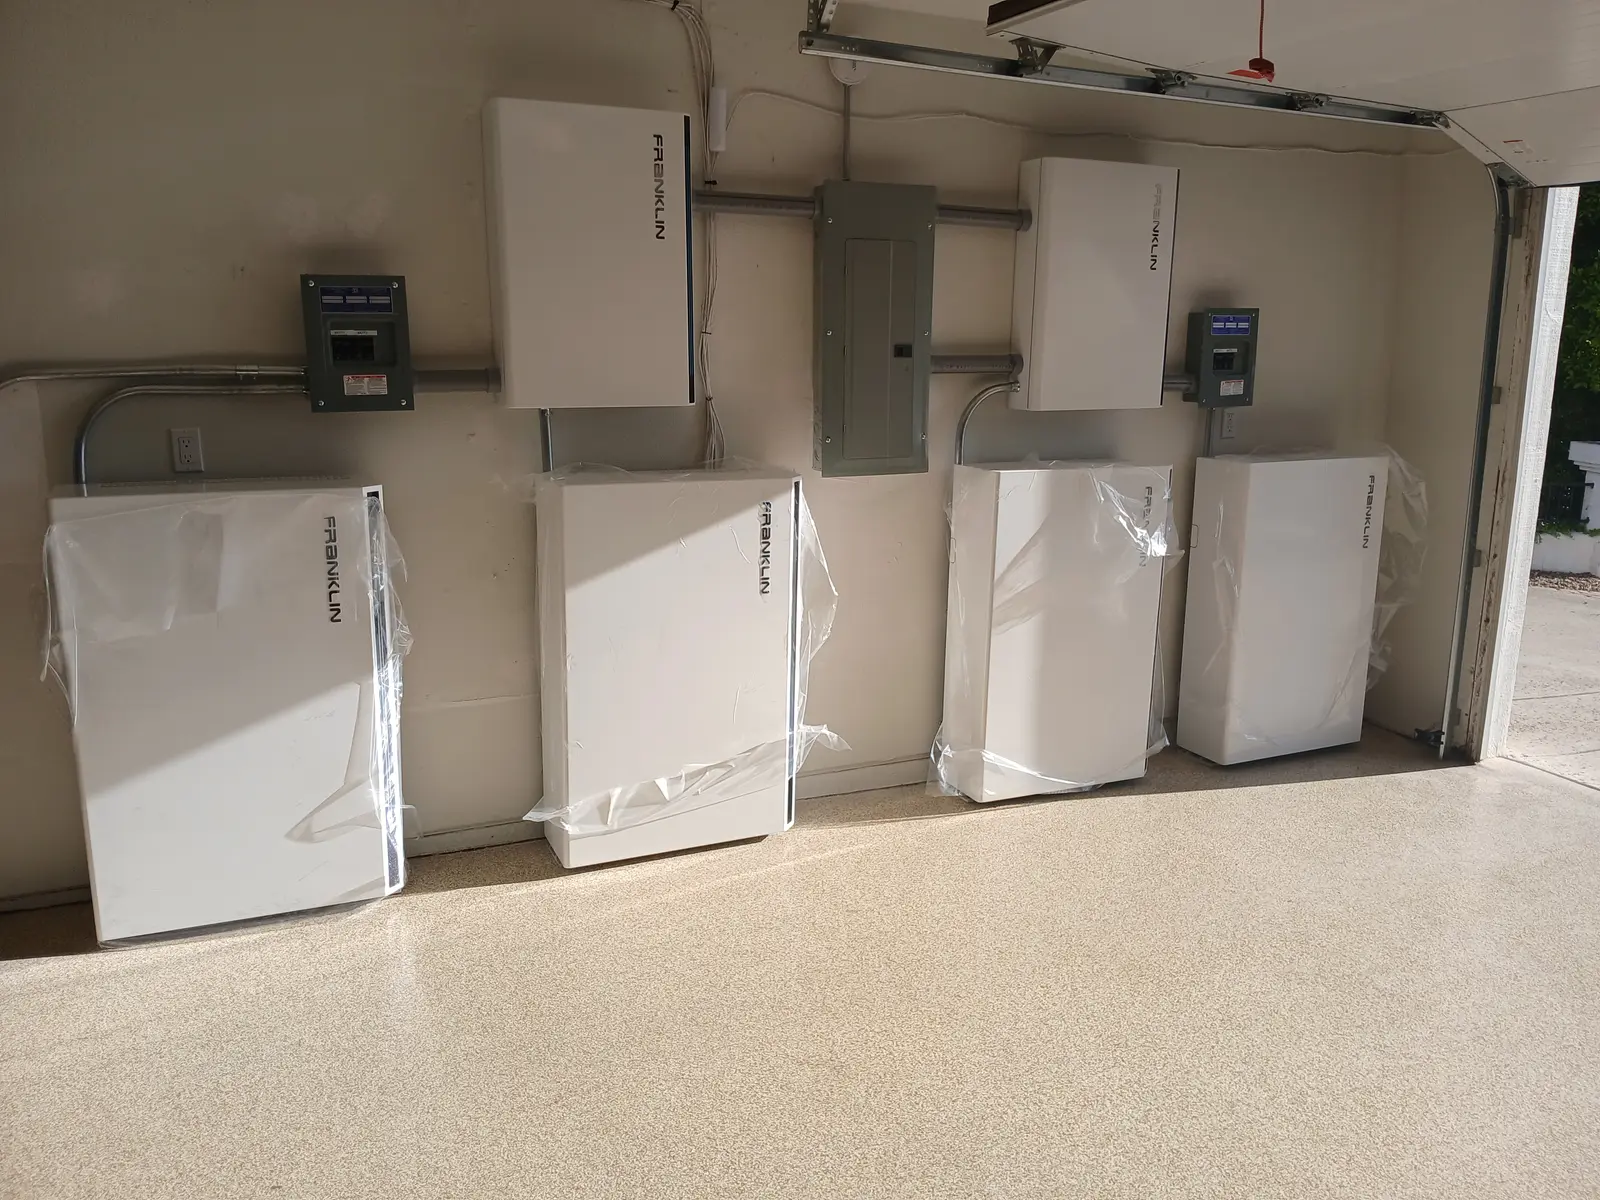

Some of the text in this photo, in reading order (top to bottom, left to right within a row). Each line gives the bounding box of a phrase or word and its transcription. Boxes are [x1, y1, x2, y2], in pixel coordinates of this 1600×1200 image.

[653, 134, 665, 240] FRANKLIN
[1149, 183, 1162, 270] FRANKLIN
[760, 501, 772, 594] FRANKLIN
[1362, 475, 1375, 549] FRANKLIN
[323, 516, 342, 623] FRANKLIN
